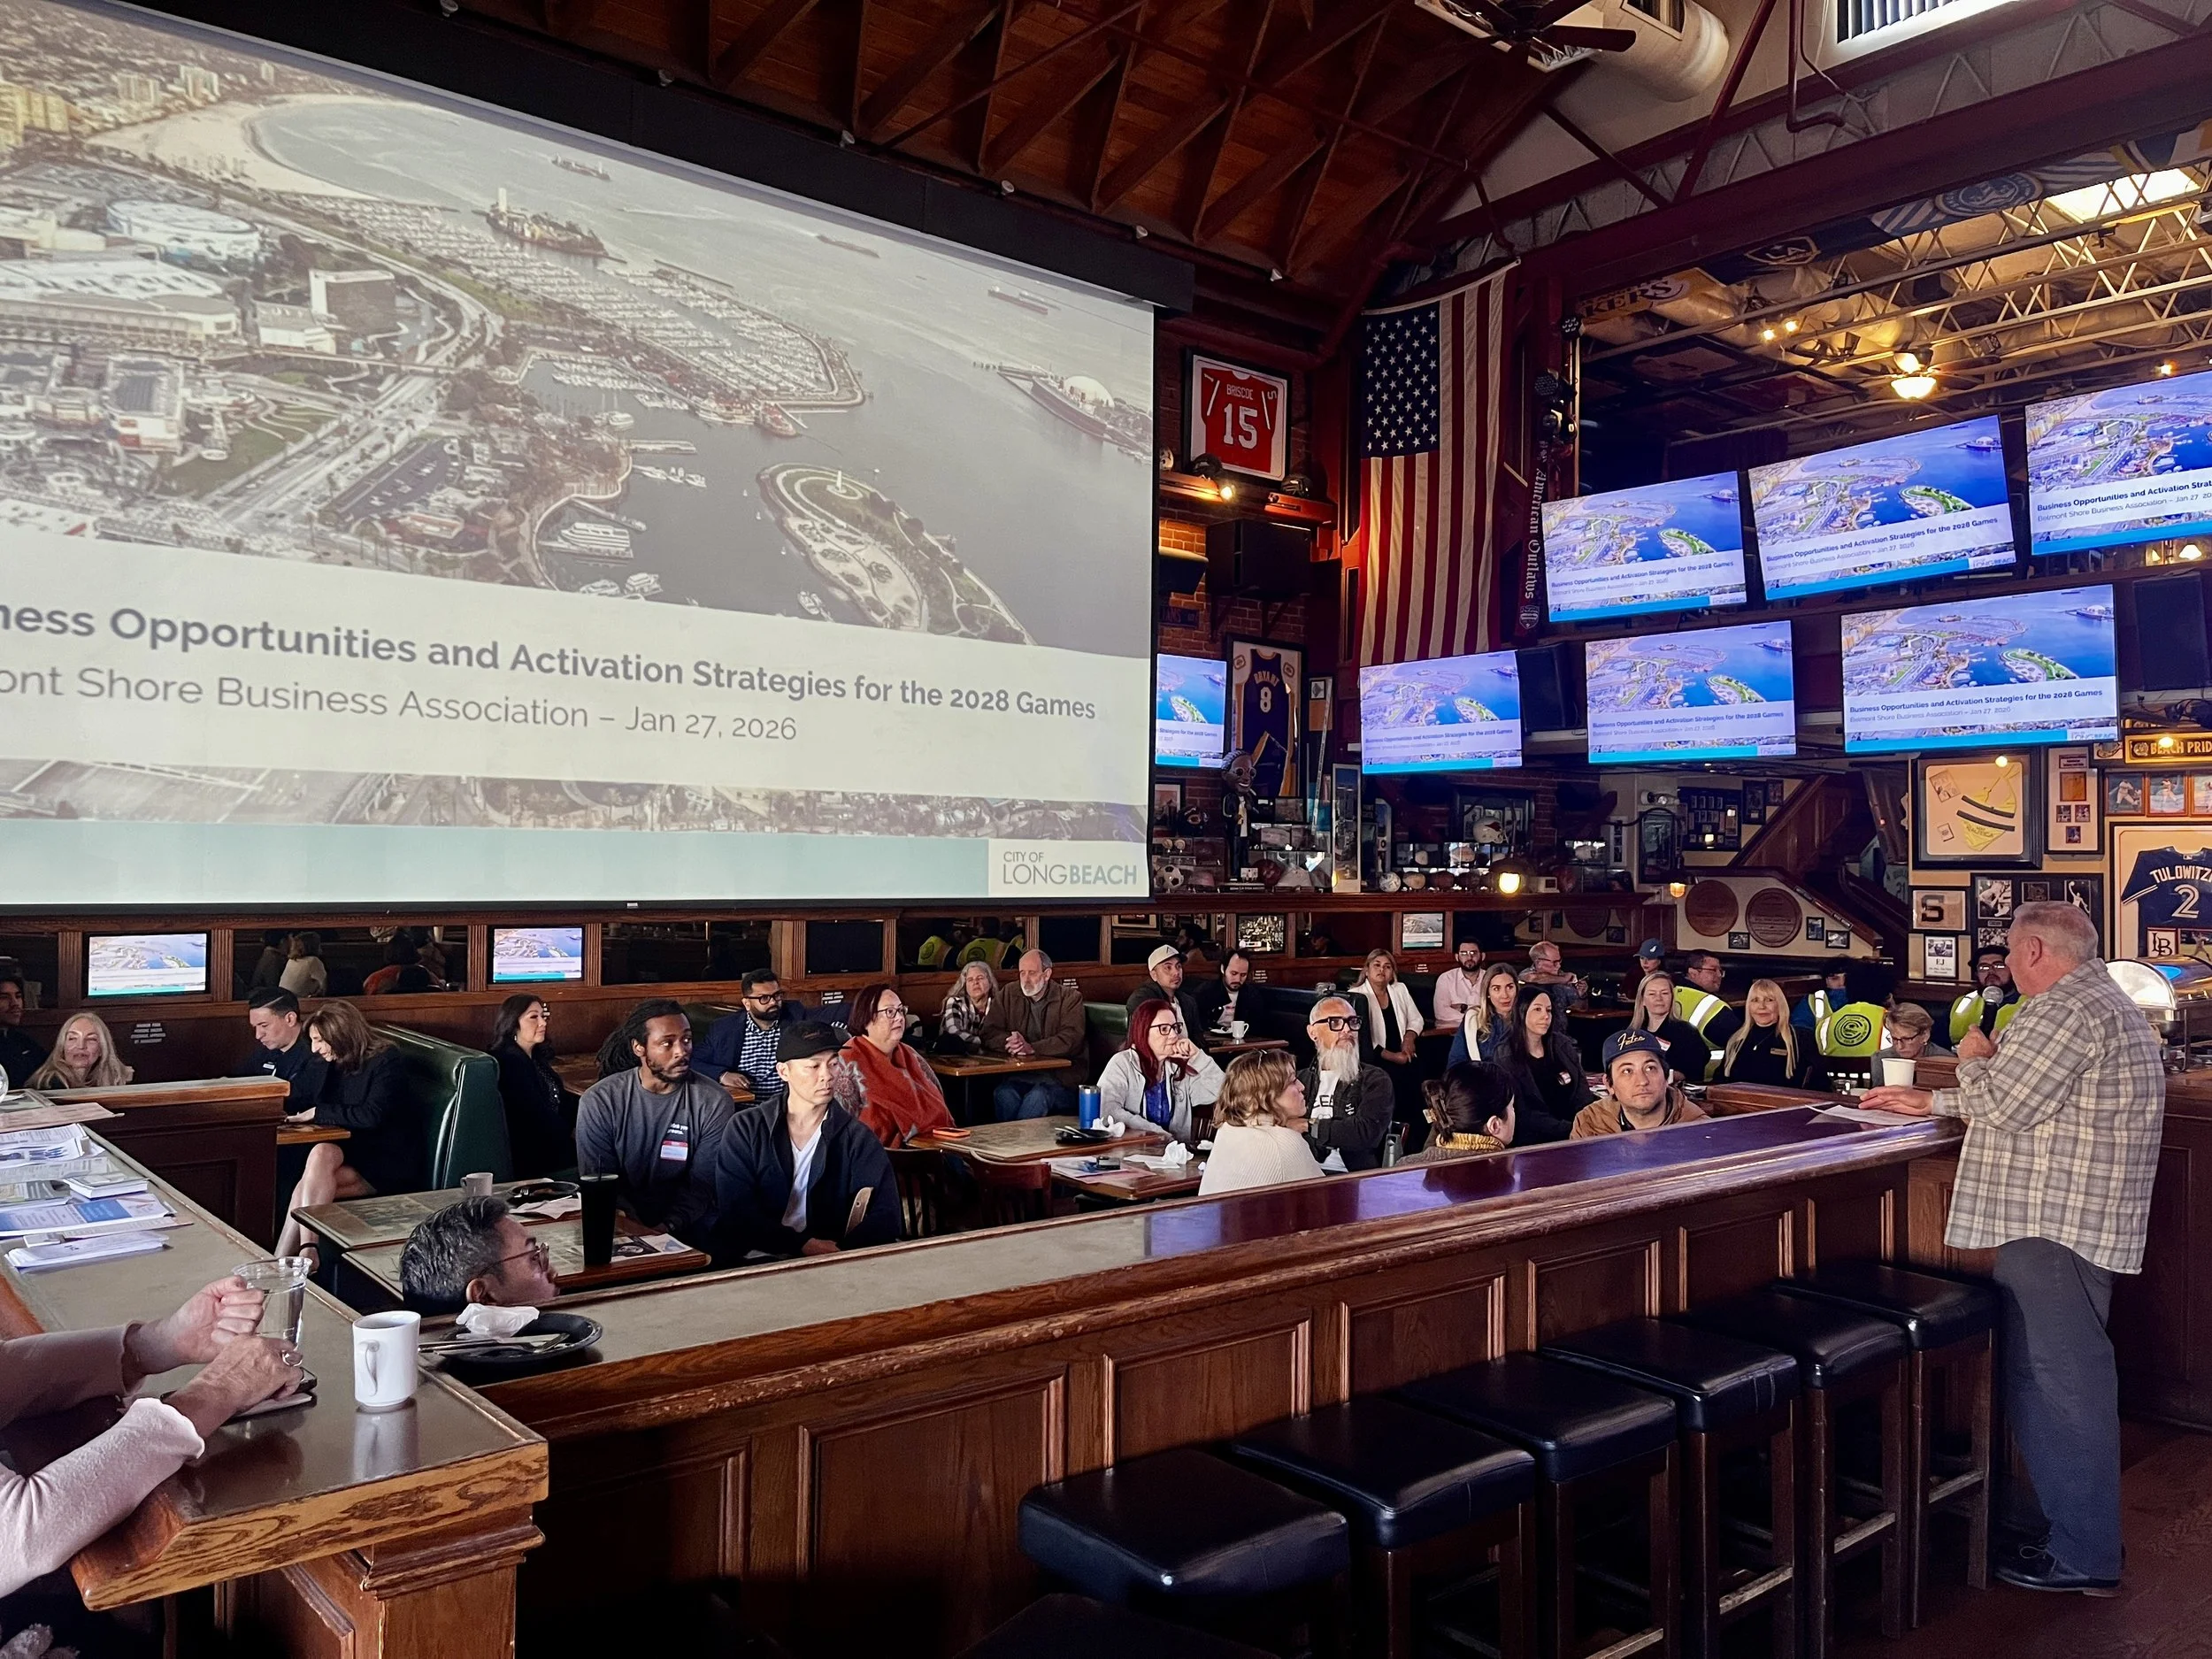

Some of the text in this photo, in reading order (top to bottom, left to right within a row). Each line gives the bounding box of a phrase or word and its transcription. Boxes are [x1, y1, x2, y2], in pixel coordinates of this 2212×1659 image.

[1226, 383, 1254, 401] BRISCOE
[1223, 403, 1258, 449] 15
[2038, 502, 2071, 511] Business
[2074, 494, 2128, 506] Opportunities
[2147, 485, 2189, 495] Activation
[2092, 505, 2124, 514] Business
[2125, 499, 2167, 510] Association
[1525, 467, 1547, 599] American Outlaws
[1795, 546, 1839, 557] Opportunities
[1854, 537, 1888, 547] Activation
[1890, 531, 1925, 541] Strategies
[1953, 521, 1970, 530] 2028
[1972, 518, 1998, 526] Games
[110, 609, 417, 662] Opportunities
[428, 641, 499, 669] and
[510, 644, 682, 684] Activation
[693, 661, 846, 701] Strategies
[854, 675, 893, 702] for
[900, 680, 942, 706] the
[950, 689, 1009, 711] 2028
[1017, 692, 1095, 718] Games
[1253, 670, 1280, 687] BRYANT
[0, 667, 64, 695] ont
[77, 668, 203, 703] Shore
[218, 677, 388, 715] Business
[398, 691, 588, 727] Association
[626, 706, 675, 733] Jan
[686, 715, 721, 739] 27,
[733, 717, 796, 740] 2026
[1259, 686, 1272, 713] 8
[1003, 851, 1044, 863] CITY OF
[1921, 895, 1944, 922] S
[2171, 884, 2200, 918] 2
